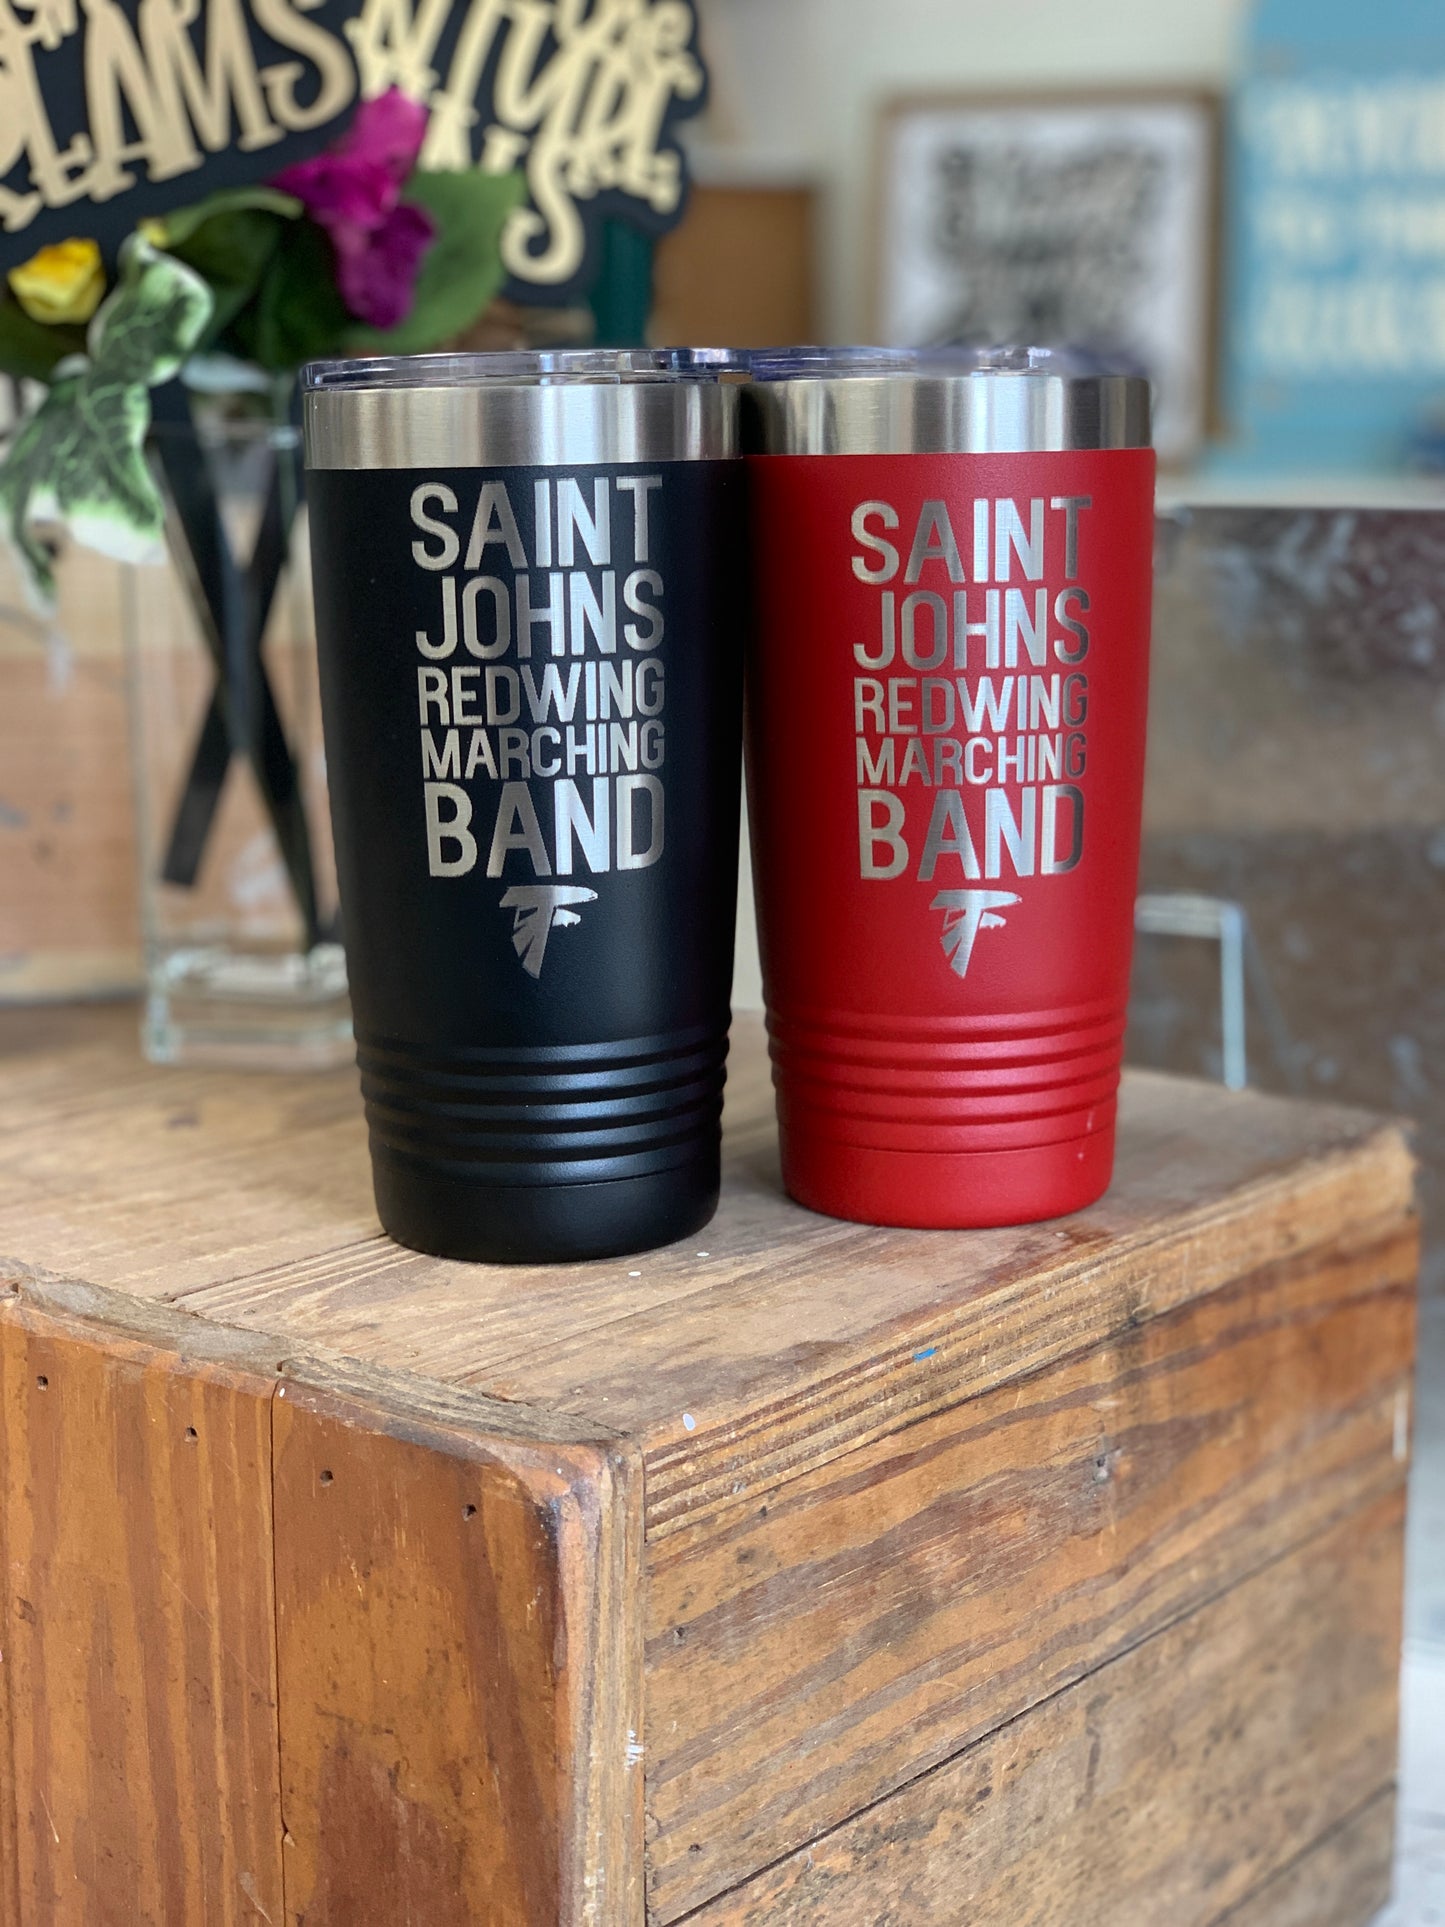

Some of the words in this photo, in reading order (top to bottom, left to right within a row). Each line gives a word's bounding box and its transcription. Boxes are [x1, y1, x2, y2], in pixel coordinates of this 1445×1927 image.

[409, 474, 663, 571] SAINT
[850, 495, 1092, 585] SAINT
[415, 568, 665, 660] JOHNS
[853, 587, 1091, 670] JOHNS
[417, 657, 665, 726] REDWING
[854, 672, 1088, 735] REDWING
[420, 719, 665, 780] MARCHING
[856, 732, 1087, 787] MARCHING
[423, 773, 665, 878] BAND
[857, 784, 1084, 881] BAND
